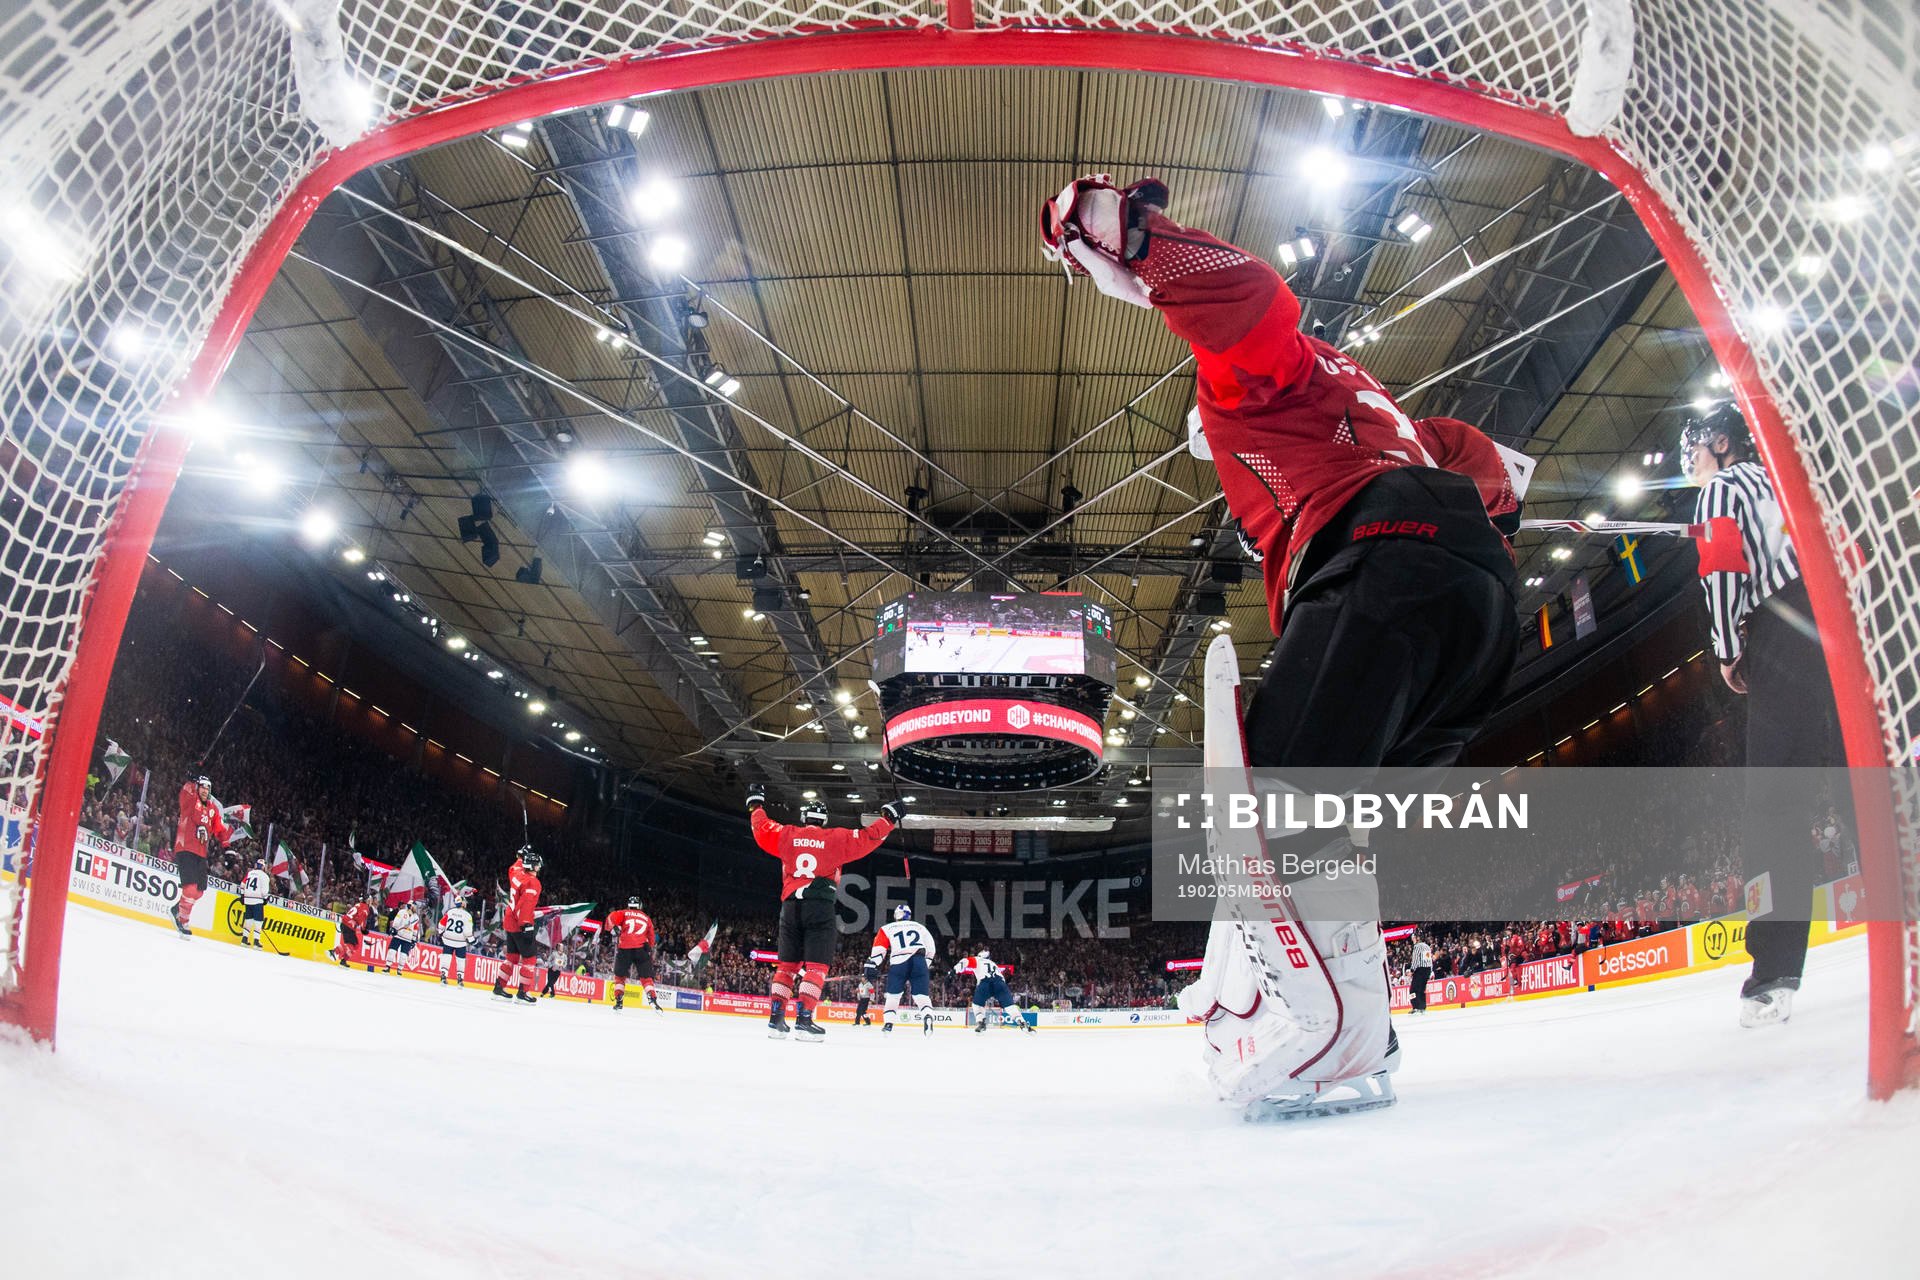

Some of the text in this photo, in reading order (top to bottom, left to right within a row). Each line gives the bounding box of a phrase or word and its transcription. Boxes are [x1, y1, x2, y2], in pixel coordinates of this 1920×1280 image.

[86, 834, 125, 857] TISSOT
[793, 838, 825, 849] EKBOM
[793, 852, 818, 879] 8
[111, 861, 181, 901] TISSO
[208, 876, 232, 892] SSOT
[72, 877, 170, 914] SWISS WATCHES SINCE
[295, 902, 323, 917] TISSOT
[835, 873, 1131, 940] SERNEKE
[447, 918, 464, 934] 28
[625, 919, 648, 935] 17
[893, 930, 923, 948] 12
[1599, 945, 1668, 976] betsson
[1521, 957, 1576, 991] #CHLFINAL
[578, 979, 596, 996] 2019
[713, 998, 752, 1008] ENGELBERT
